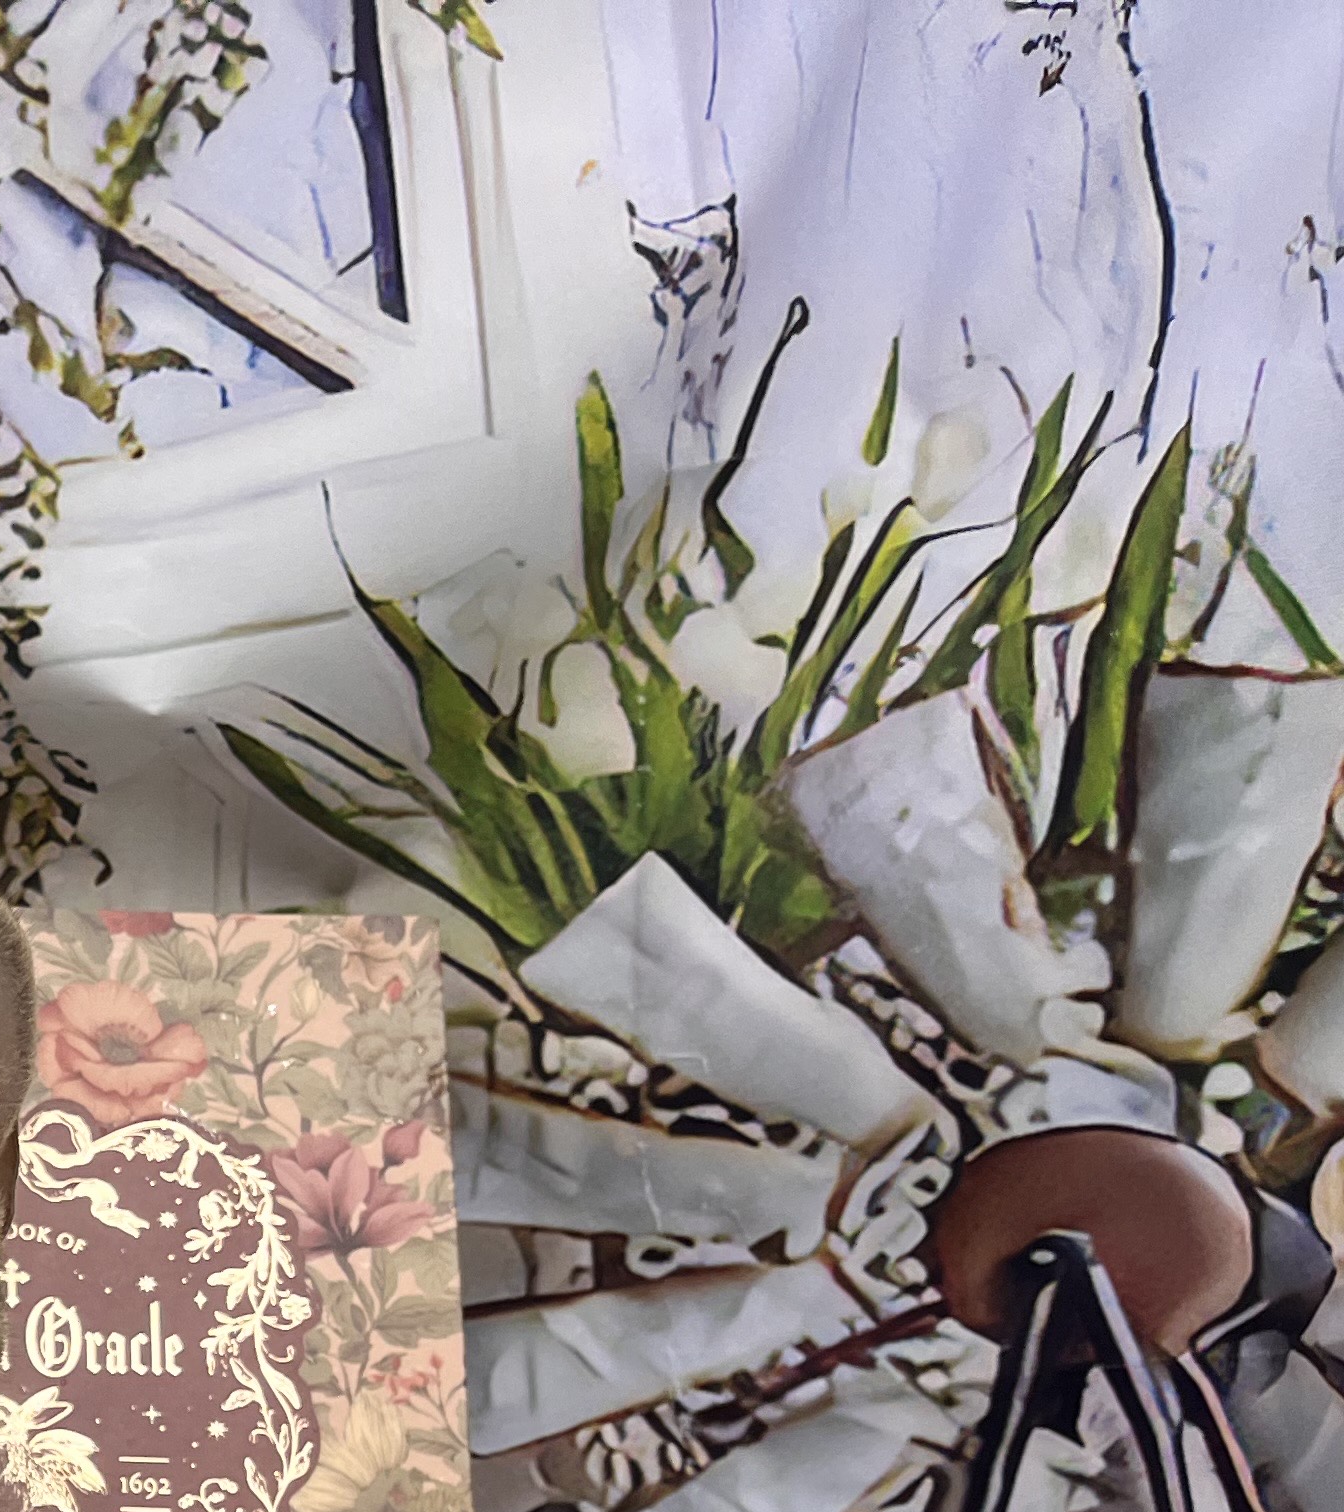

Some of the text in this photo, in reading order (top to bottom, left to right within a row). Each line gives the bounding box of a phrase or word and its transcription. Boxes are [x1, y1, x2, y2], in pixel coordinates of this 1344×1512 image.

[6, 1223, 88, 1254] OOK OF
[25, 1296, 185, 1377] Oracle
[119, 1471, 172, 1500] 1692
